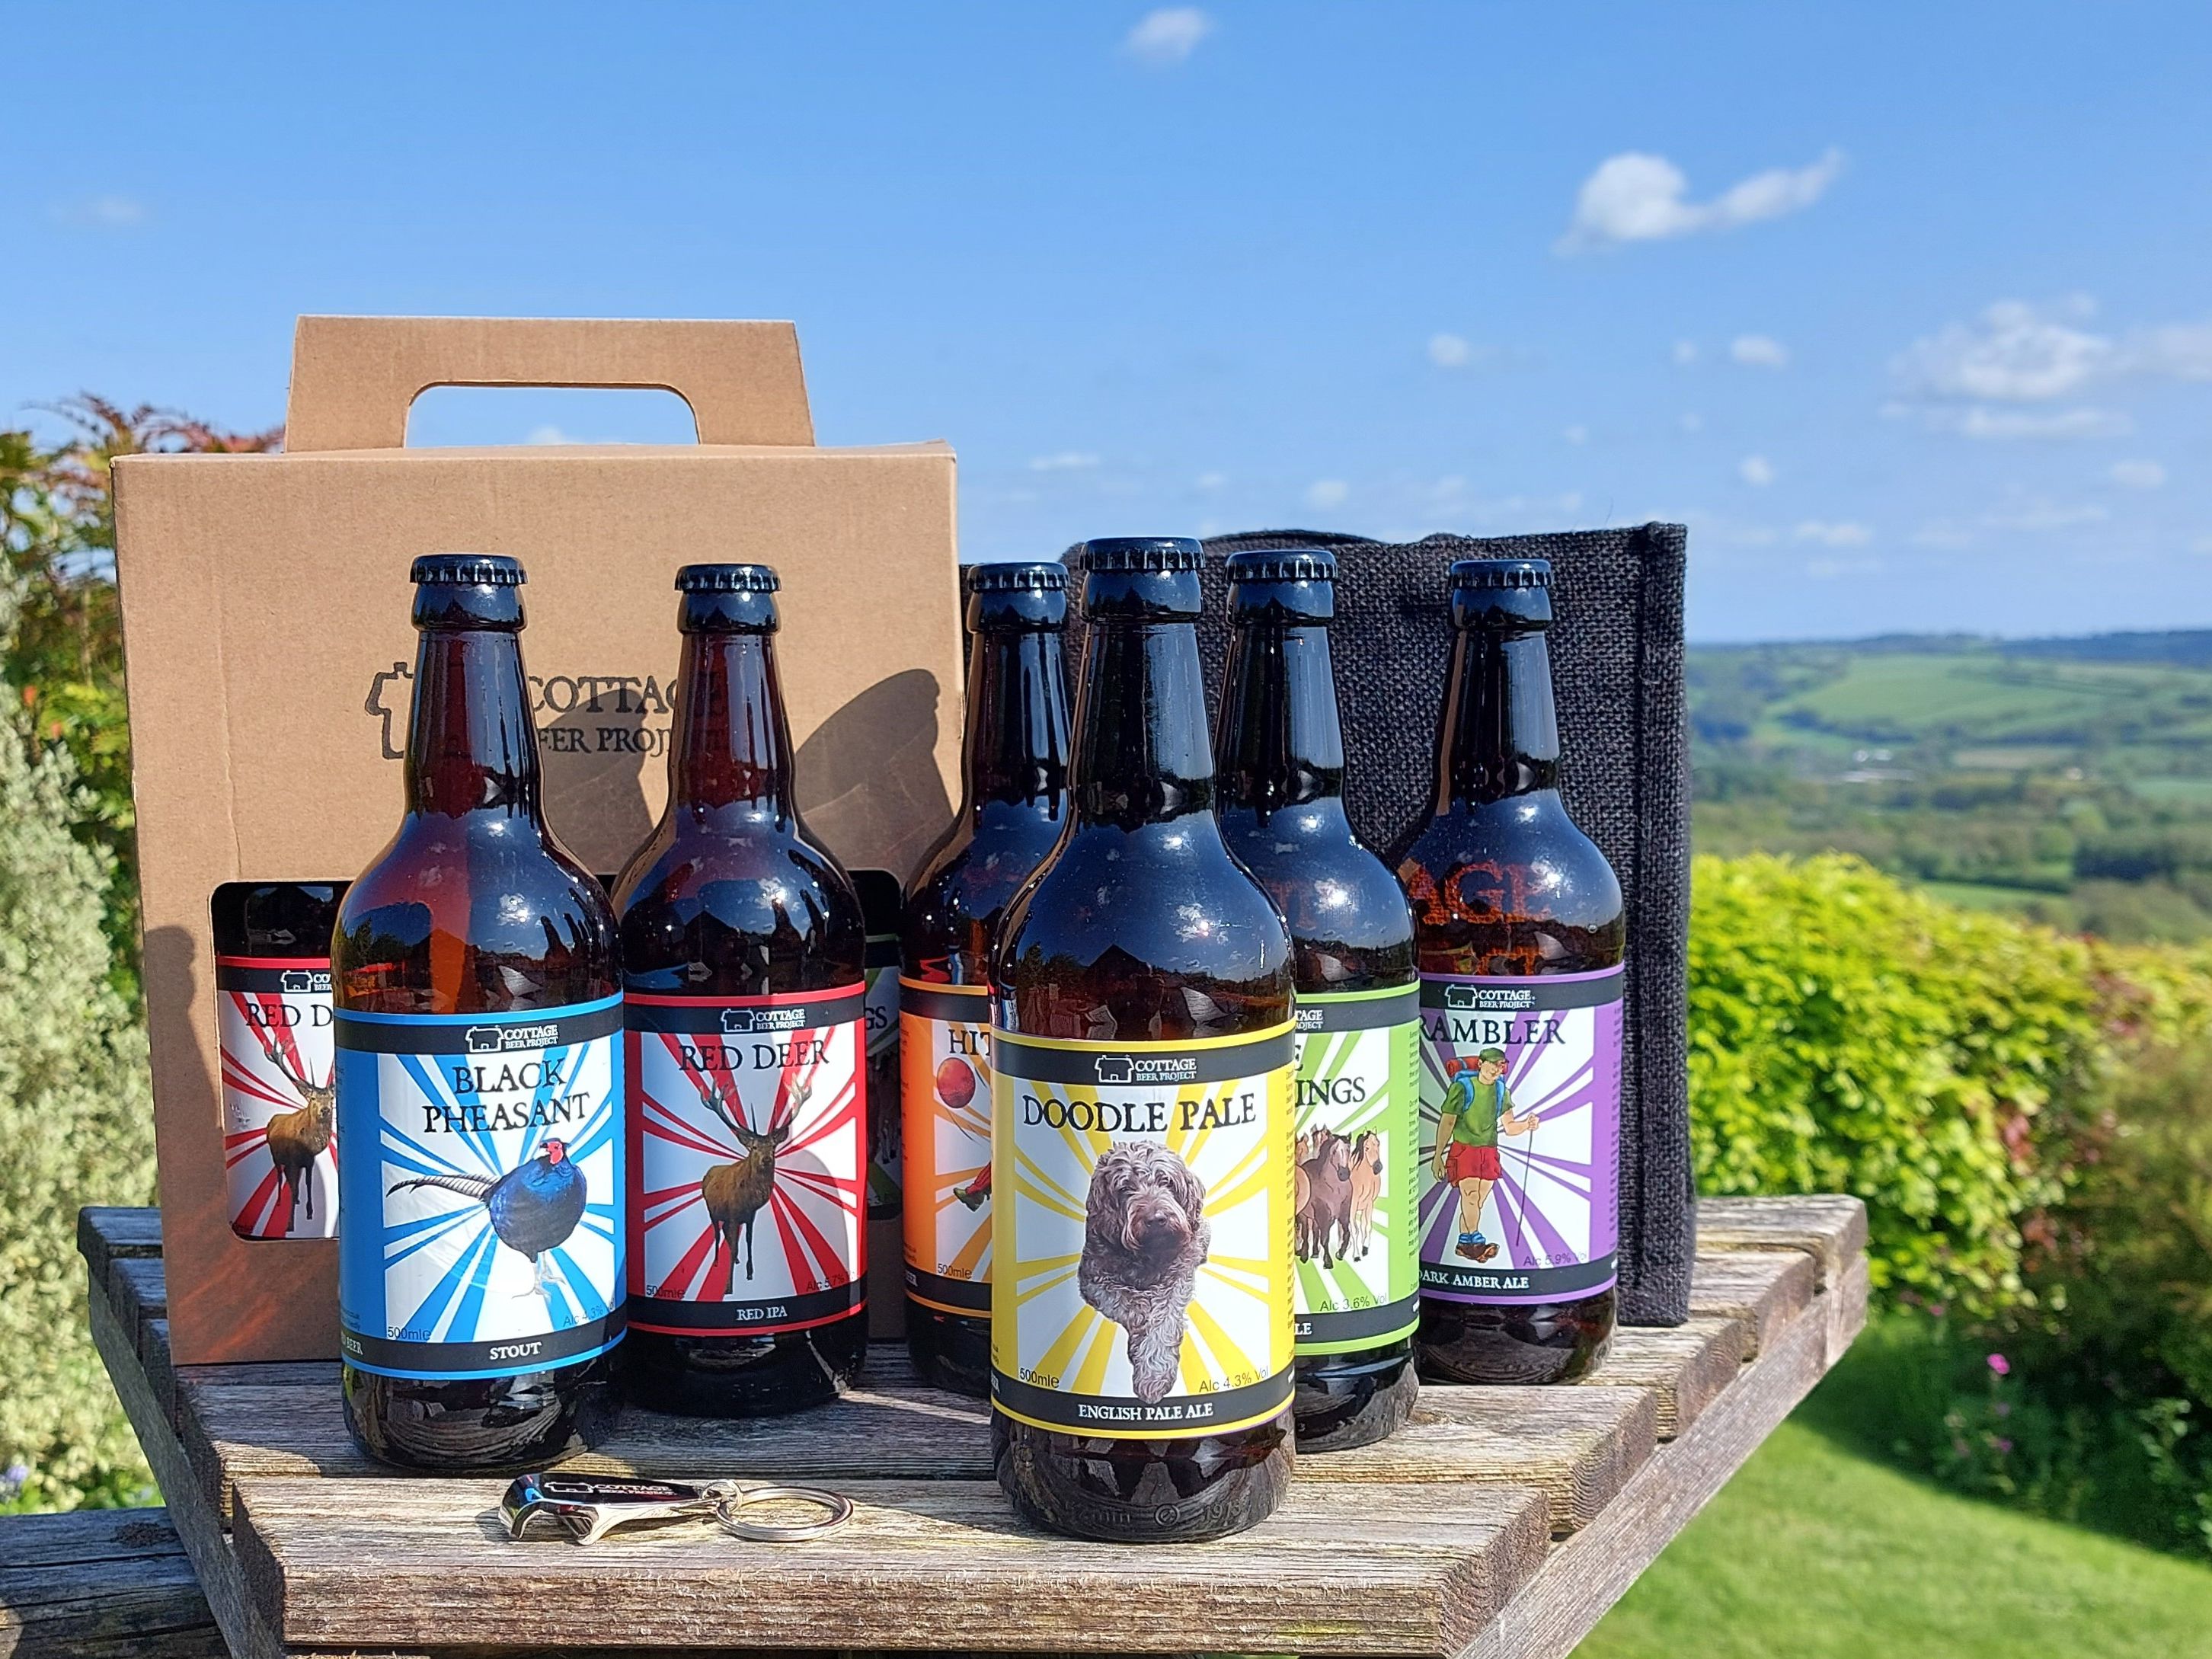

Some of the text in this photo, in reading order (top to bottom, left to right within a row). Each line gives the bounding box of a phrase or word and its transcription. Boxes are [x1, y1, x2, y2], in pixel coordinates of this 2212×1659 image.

[1478, 990, 1531, 1001] COTTAGE
[246, 1002, 334, 1028] RED D
[756, 1009, 806, 1022] COTTAGE
[503, 1024, 558, 1040] COTTAGE
[756, 1019, 806, 1030] BEER PROJECT
[505, 1036, 558, 1050] BEER PROJECT
[679, 1040, 830, 1072] RED DEER
[1135, 1058, 1197, 1072] COTTAGE
[452, 1057, 567, 1094] BLACK
[1136, 1071, 1197, 1082] BEER PROJECT
[422, 1092, 590, 1133] PHEASANT
[1022, 1092, 1257, 1133] DOODLE PALE
[1453, 1274, 1501, 1290] AMBER
[1502, 1276, 1530, 1289] ALE
[1320, 1293, 1387, 1312] Alc 3.6% Vol
[736, 1306, 788, 1321] RED IPA
[490, 1341, 542, 1360] STOUT
[1199, 1366, 1268, 1393] Alc 4.3% Vol
[1078, 1402, 1213, 1421] ENGLISH PALE ALE
